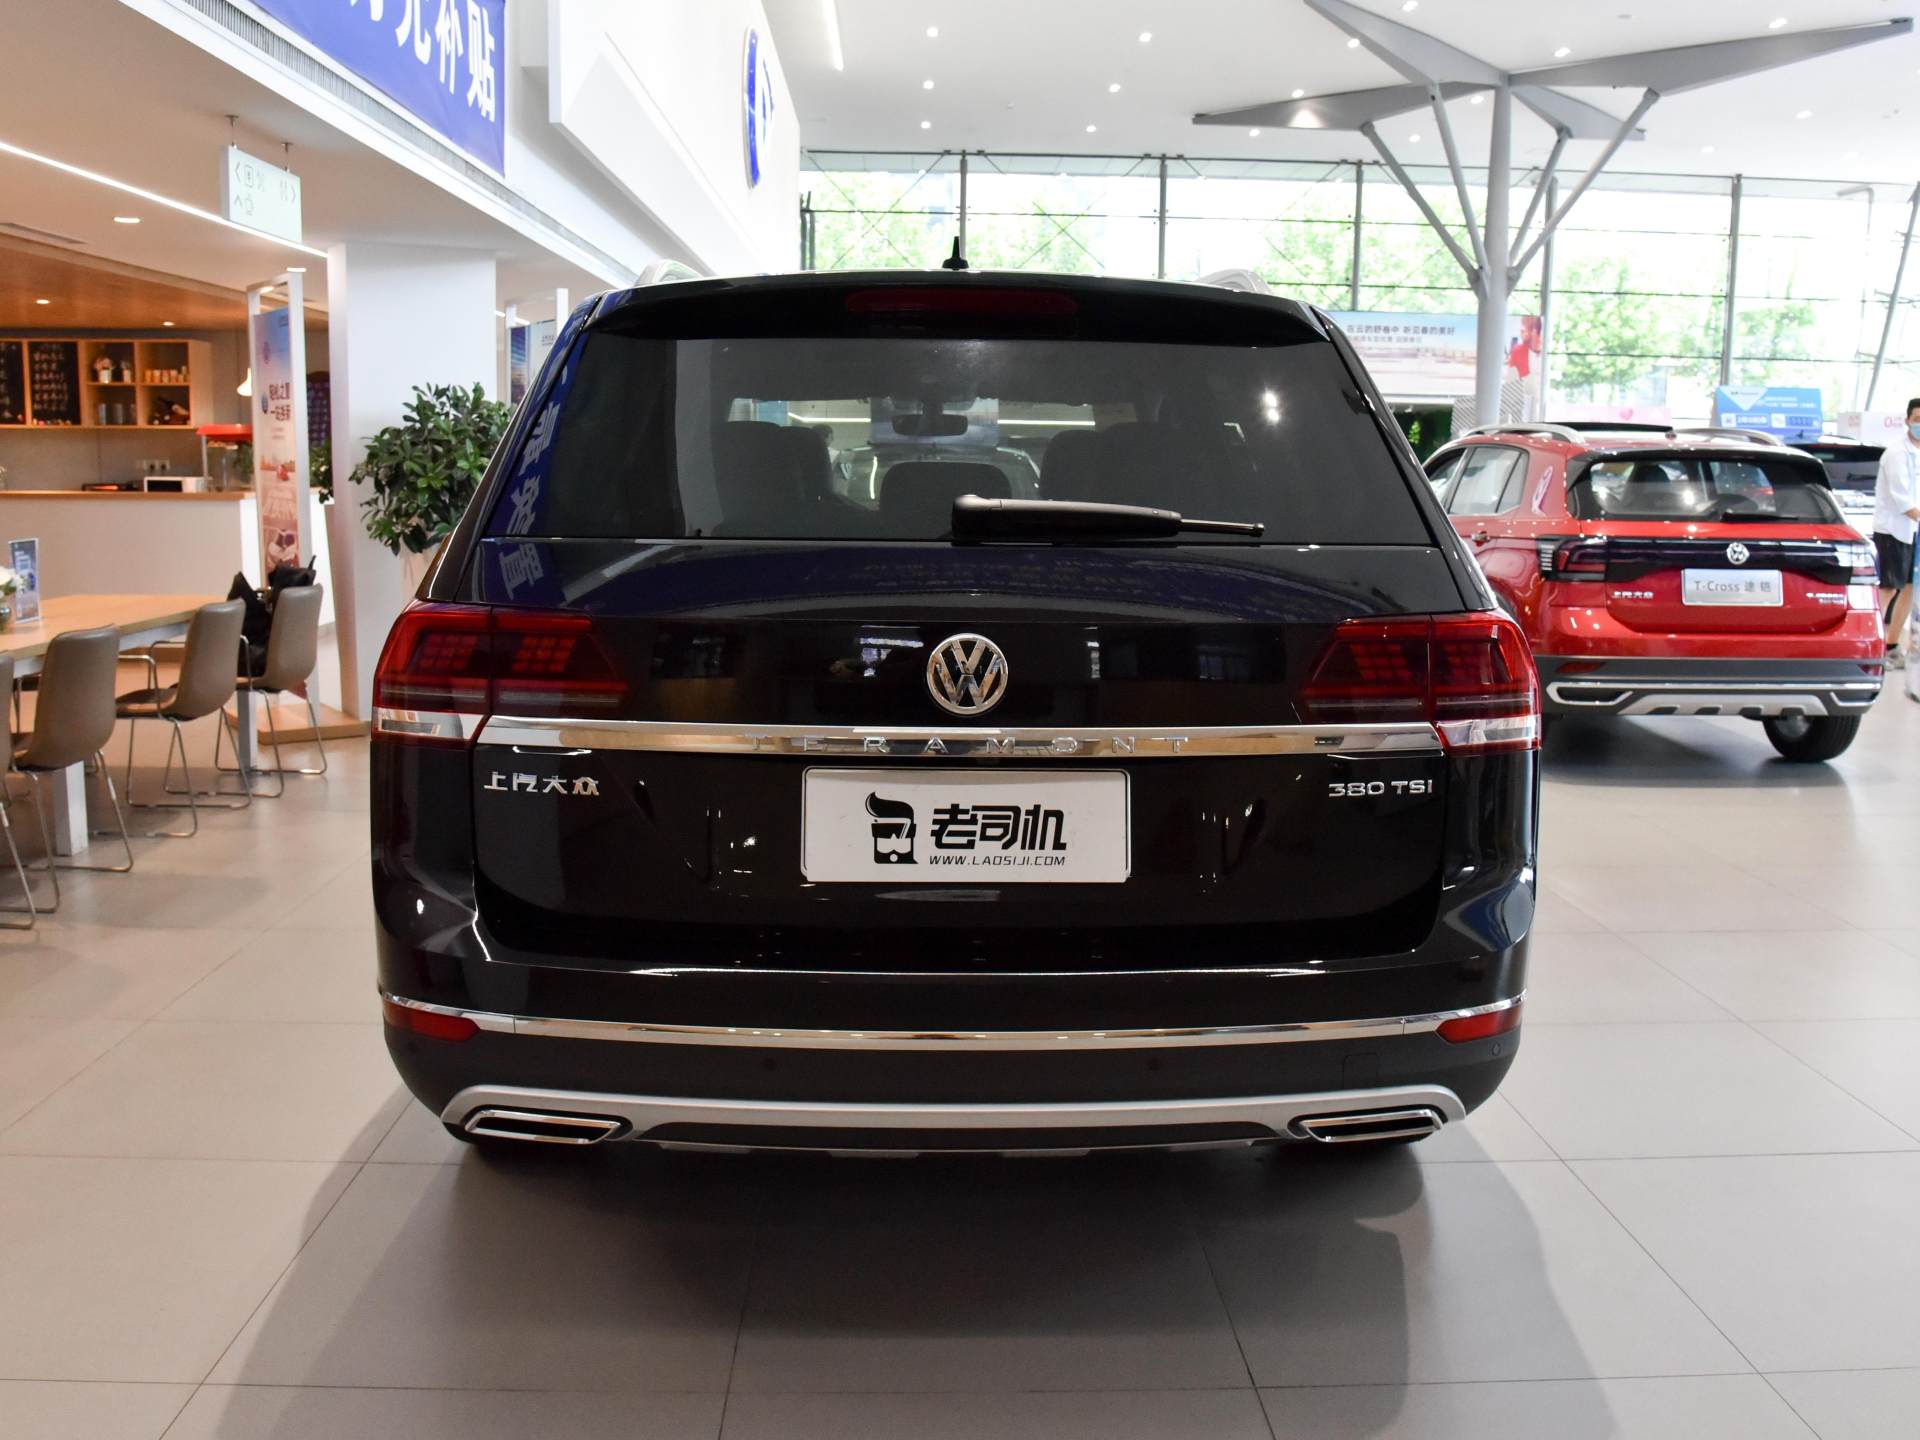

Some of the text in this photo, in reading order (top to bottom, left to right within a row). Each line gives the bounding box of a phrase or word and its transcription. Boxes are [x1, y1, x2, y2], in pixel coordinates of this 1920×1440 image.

[1694, 580, 1740, 593] T-Cross
[927, 633, 1009, 715] VW
[751, 734, 1189, 755] TERAMONT
[483, 771, 600, 797] 上汽大众
[1328, 781, 1385, 797] 380
[929, 803, 1067, 851] 老司机
[929, 854, 1066, 867] WWW.LAOSIJI.COM
